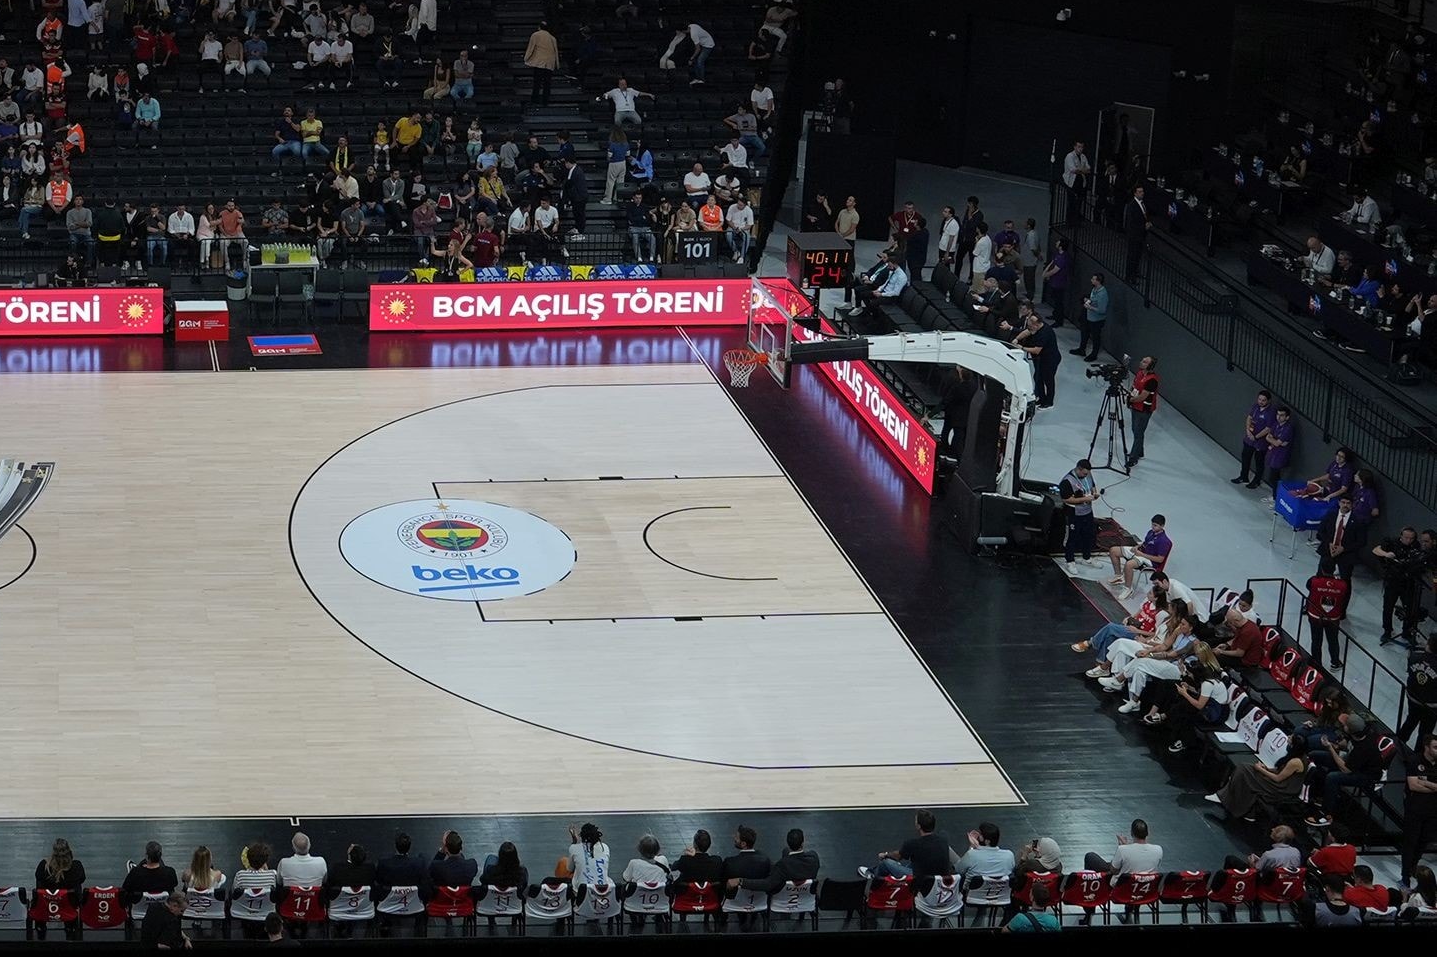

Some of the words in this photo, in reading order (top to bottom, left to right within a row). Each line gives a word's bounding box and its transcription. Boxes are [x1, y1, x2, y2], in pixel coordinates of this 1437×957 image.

[684, 243, 711, 258] 101
[806, 251, 850, 265] 40:11
[811, 266, 841, 285] 24
[432, 295, 502, 318] BGM
[508, 293, 606, 322] AÇILIŞ
[611, 285, 724, 314] TÖRENİ
[178, 320, 202, 328] BGM
[864, 381, 909, 451] TÖRENİ
[445, 513, 478, 523] SPOR
[411, 565, 520, 581] beko
[1080, 881, 1101, 893] 10
[1131, 881, 1151, 893] 14
[1235, 881, 1246, 892] 9
[1282, 881, 1292, 894] 7
[639, 893, 660, 905] 10
[887, 887, 901, 900] 7
[0, 900, 9, 911] 7
[48, 901, 59, 913] 6
[98, 900, 109, 913] 9
[189, 898, 212, 908] 23
[294, 897, 311, 911] 11
[348, 897, 359, 907] 8
